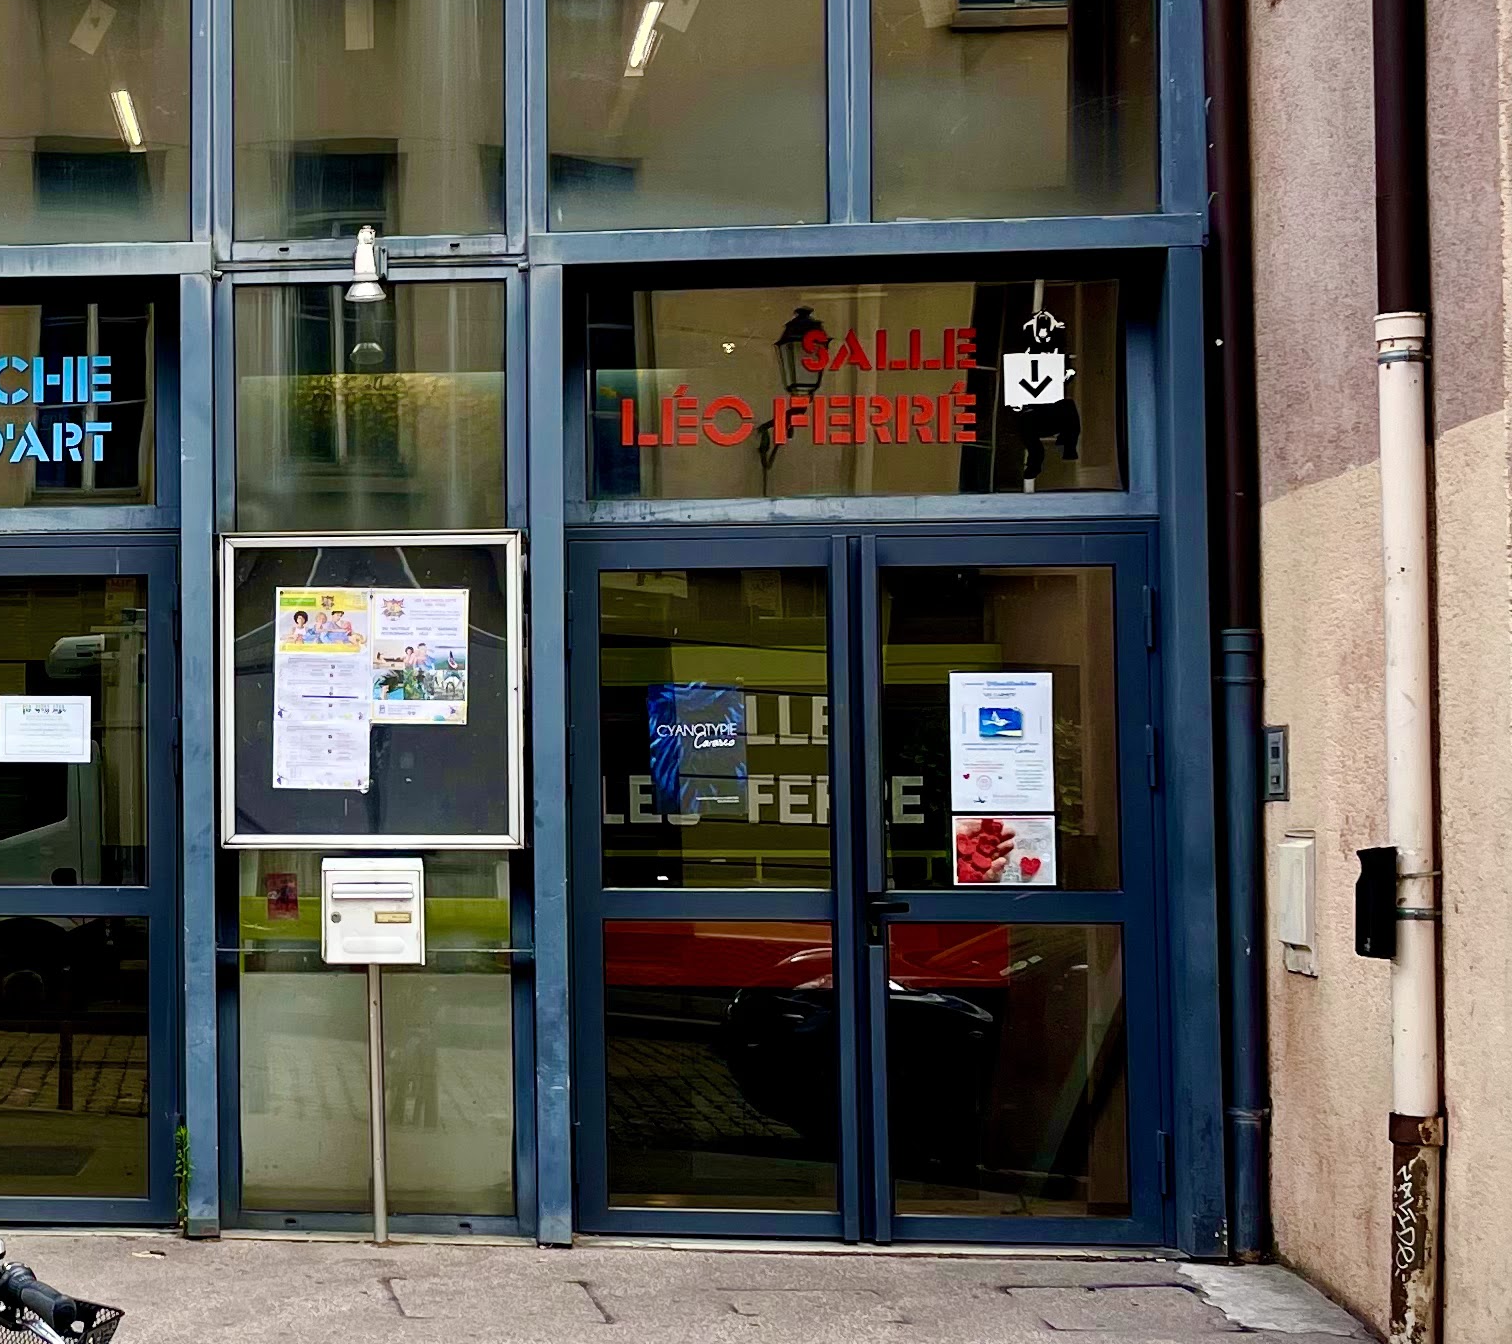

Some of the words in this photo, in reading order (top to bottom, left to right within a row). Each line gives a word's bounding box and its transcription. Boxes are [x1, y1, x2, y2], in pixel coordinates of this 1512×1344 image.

[801, 327, 977, 372] SALLE
[620, 384, 754, 447] LÉO
[773, 381, 977, 445] FERRÉ
[746, 696, 828, 745] LLE
